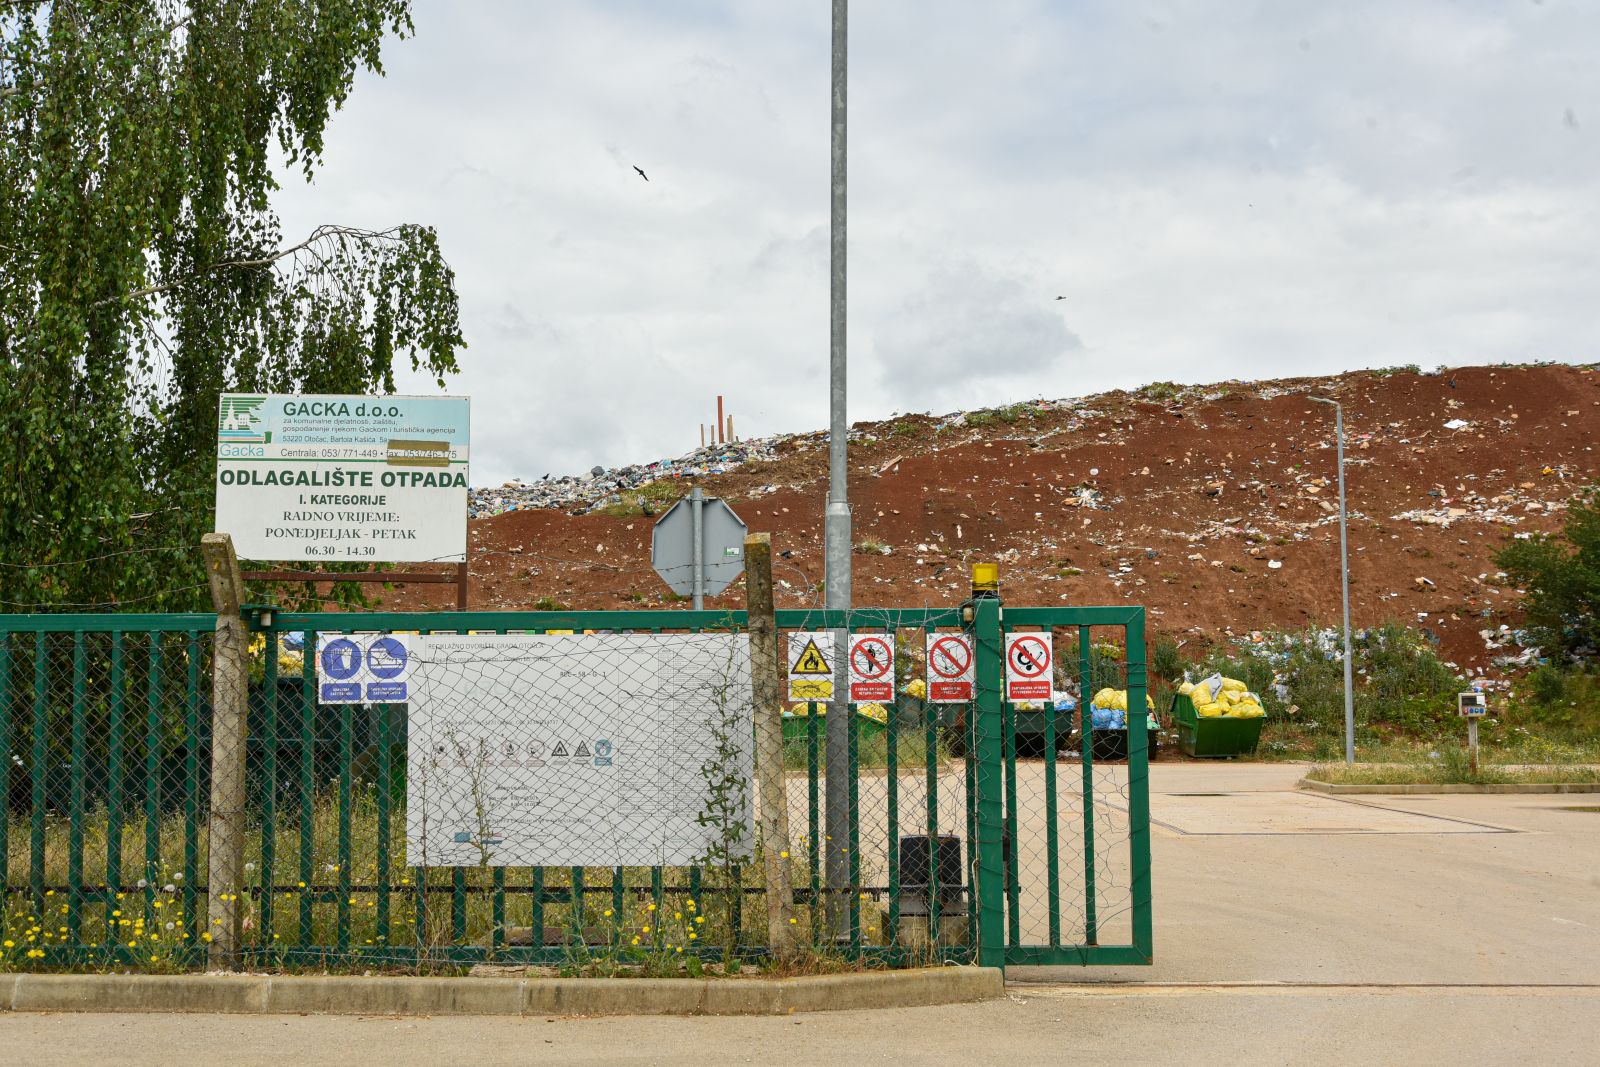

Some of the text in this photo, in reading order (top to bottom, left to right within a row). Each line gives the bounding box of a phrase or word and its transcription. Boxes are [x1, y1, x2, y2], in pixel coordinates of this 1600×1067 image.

[283, 402, 404, 417] GACKA d.o.o.
[282, 435, 303, 443] 53220
[220, 444, 265, 457] Gacka
[280, 448, 319, 458] Centrala:
[343, 449, 378, 458] 771-449
[219, 467, 467, 488] ODLAGALIŠTE OTPADA
[310, 494, 387, 506] KATEGORIJE
[283, 511, 400, 524] RADNO VRIJEME:
[265, 527, 361, 541] PONEDJELJAK
[372, 528, 417, 540] PETAK
[305, 545, 335, 556] 06.30
[346, 546, 376, 556] 14.30
